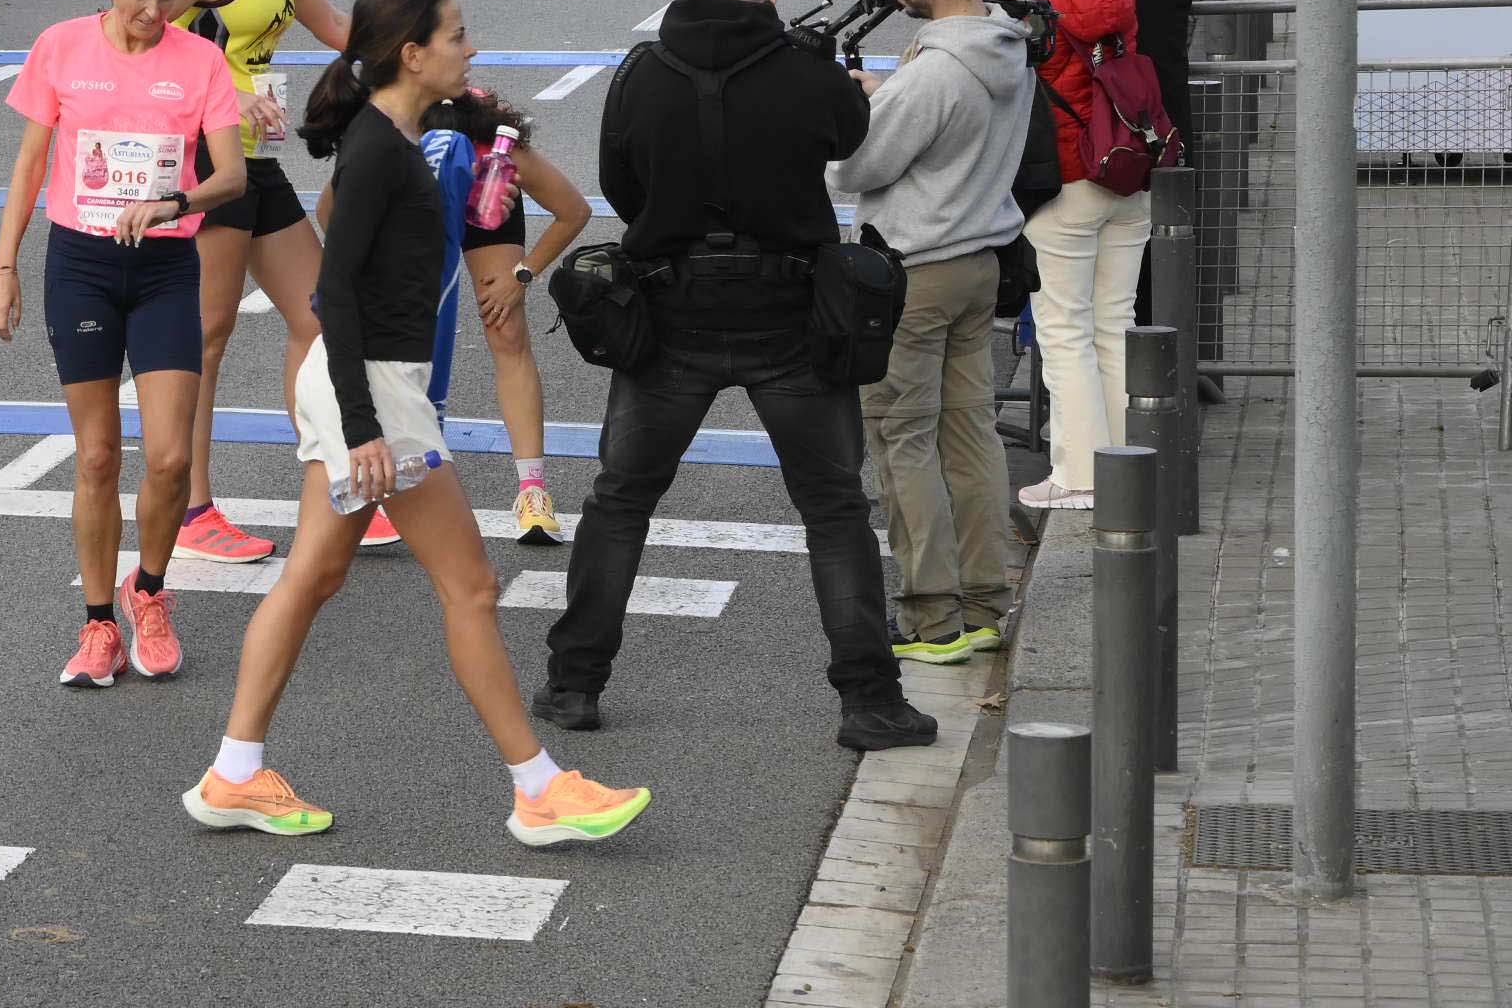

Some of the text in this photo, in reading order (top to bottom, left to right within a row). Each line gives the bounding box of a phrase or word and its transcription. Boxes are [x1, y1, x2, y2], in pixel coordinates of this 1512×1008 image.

[72, 80, 114, 91] OYSHO
[112, 170, 147, 184] 016
[118, 188, 139, 197] 3408
